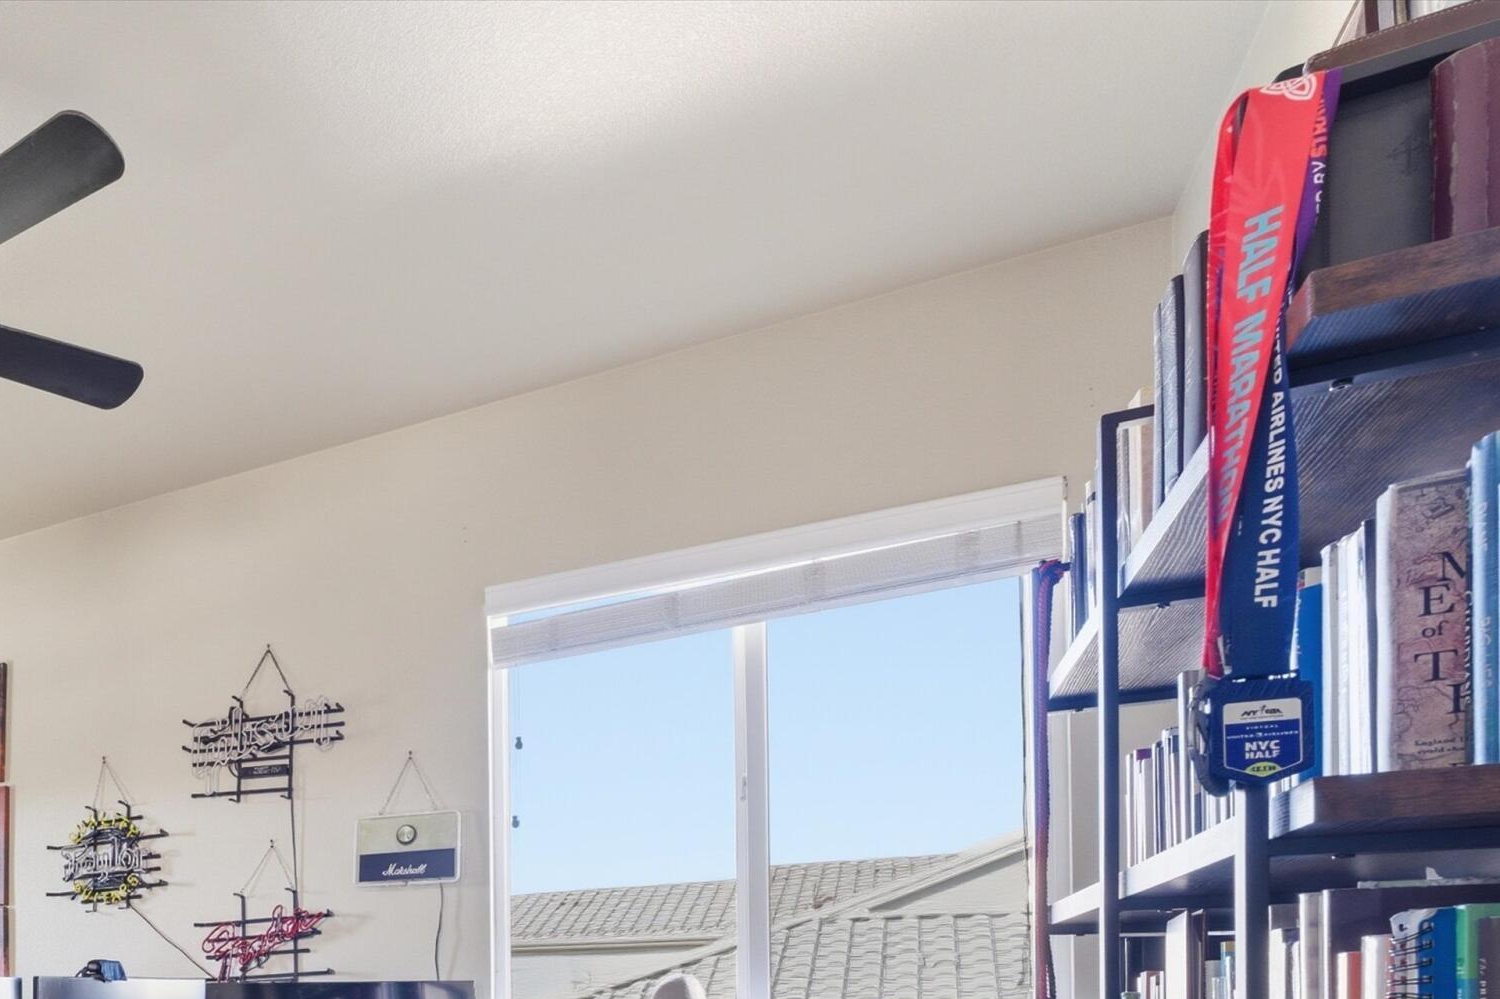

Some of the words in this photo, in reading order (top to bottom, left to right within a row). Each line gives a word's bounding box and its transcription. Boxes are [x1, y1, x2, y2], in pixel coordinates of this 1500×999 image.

[1237, 204, 1284, 303] HALF
[1216, 309, 1268, 520] MARATHON
[1265, 391, 1286, 492] AIRLINES
[1259, 494, 1285, 544] NYC
[1253, 548, 1281, 608] HALF
[1422, 620, 1448, 638] of
[1244, 740, 1280, 752] NYC
[1244, 750, 1280, 760] HALF
[382, 863, 428, 877] Marshall
